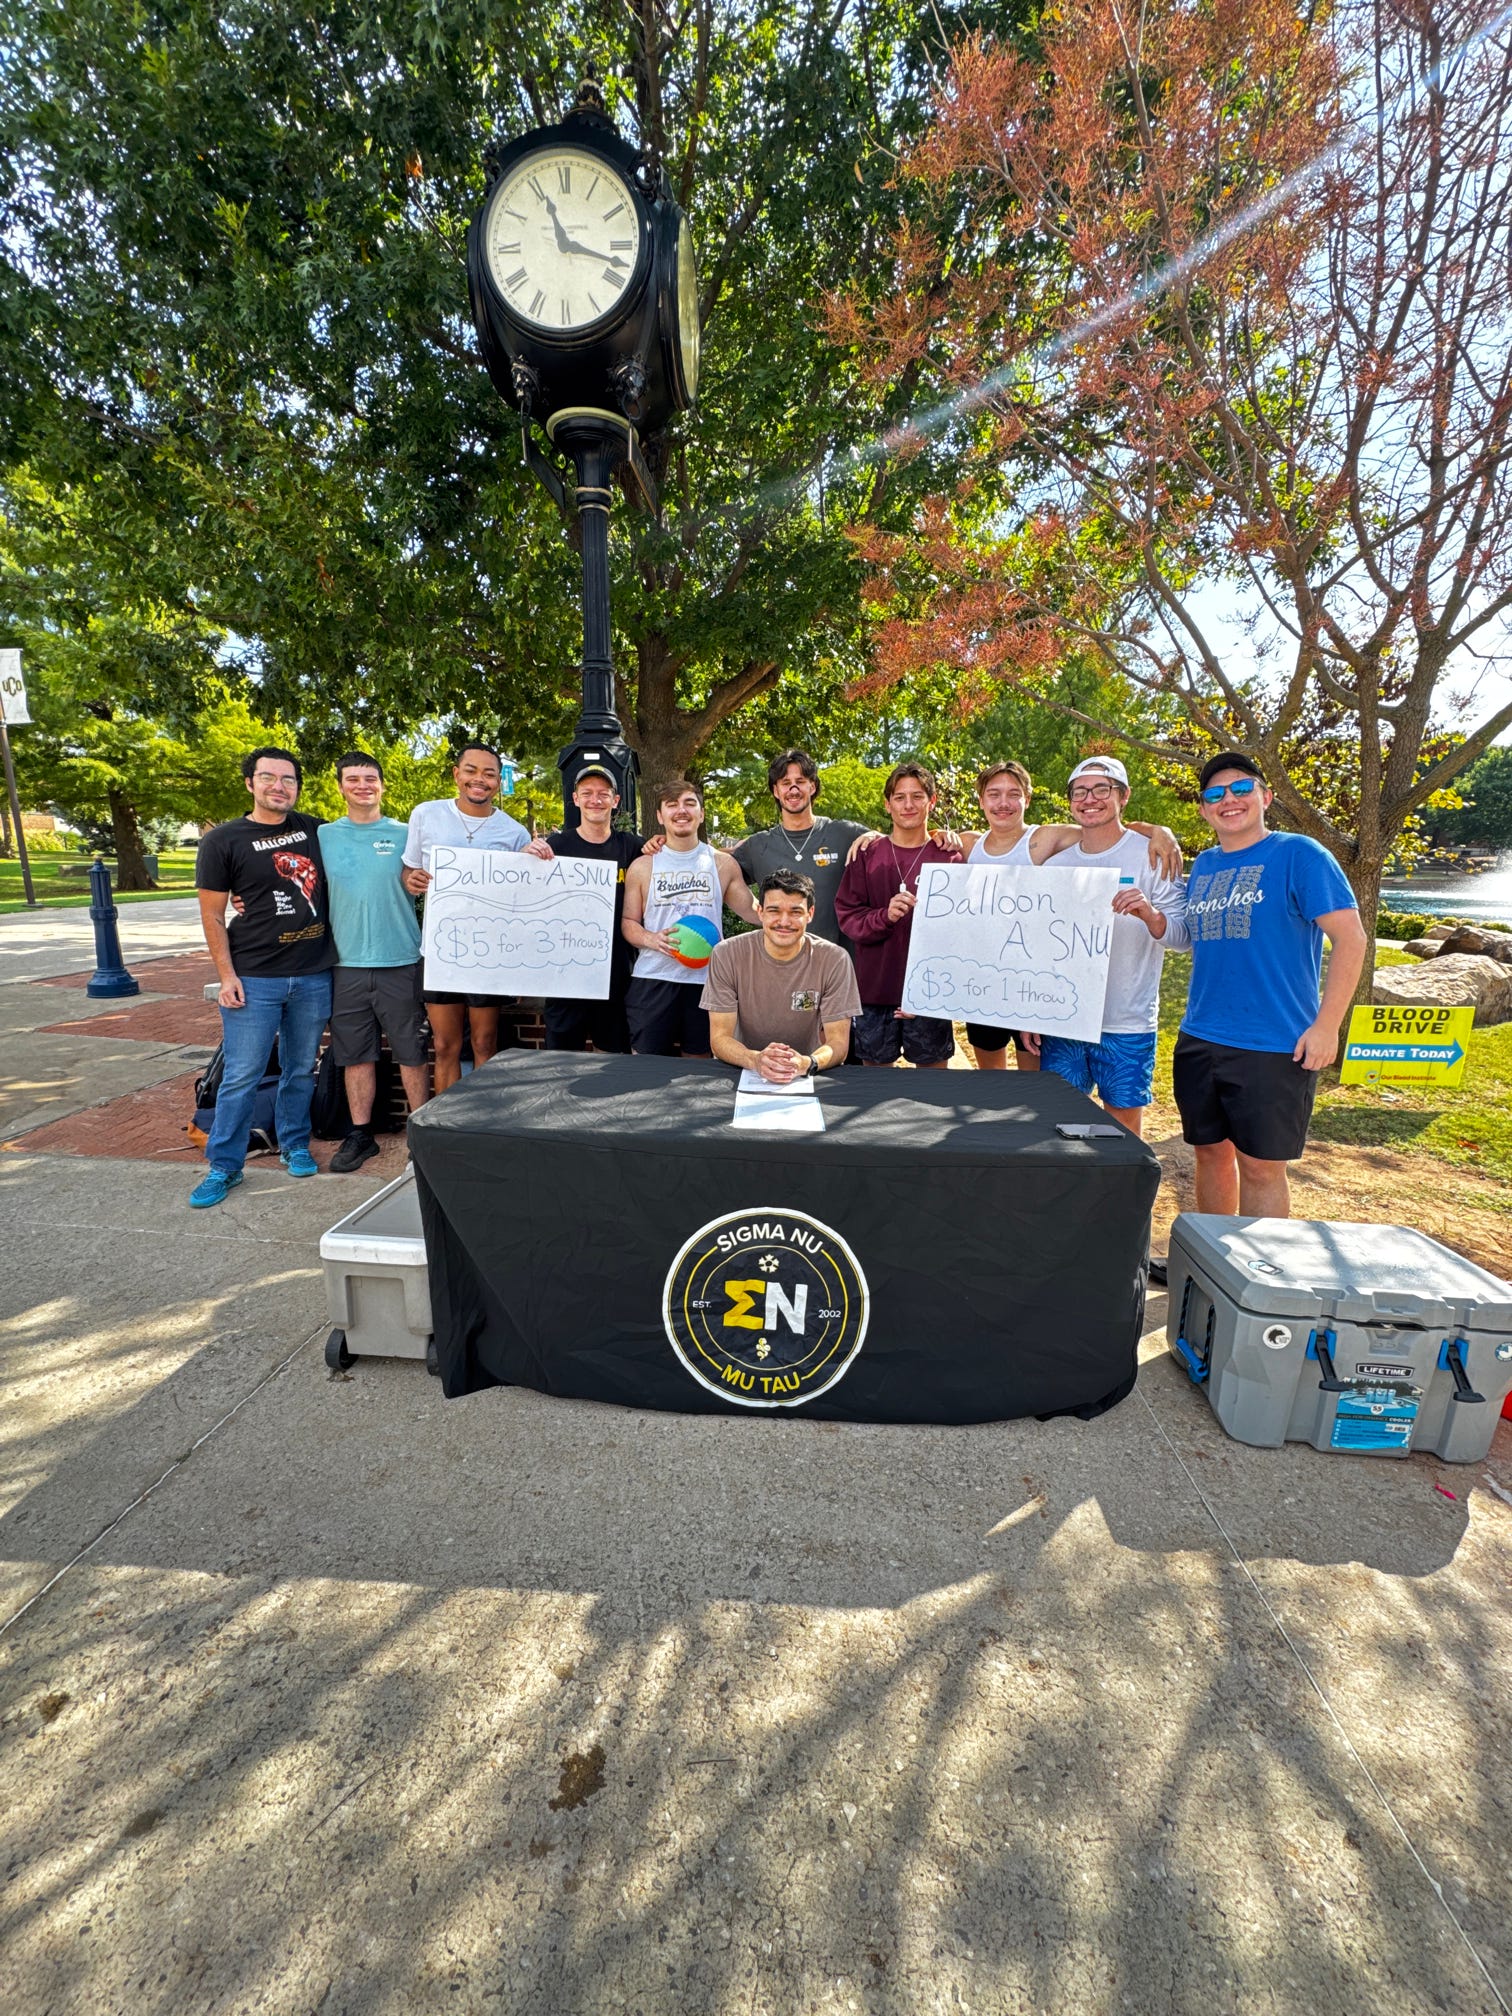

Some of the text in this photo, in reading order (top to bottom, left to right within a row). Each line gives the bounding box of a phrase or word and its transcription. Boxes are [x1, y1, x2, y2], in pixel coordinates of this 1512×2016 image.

[2, 677, 23, 696] UCO
[252, 831, 309, 852] HALLOWEEN
[657, 875, 707, 892] Bronchos
[925, 869, 1056, 918] Balloon
[448, 925, 604, 960] $5 for 3 throws
[999, 919, 1110, 961] A SNU
[921, 967, 1066, 1004] $3 for 1 throw
[1372, 1008, 1451, 1021] BLOOD
[1373, 1021, 1445, 1035] DRIVE
[716, 1223, 823, 1254] SIGMA NU
[692, 1300, 712, 1309] EST.
[818, 1309, 841, 1319] 2002
[721, 1364, 800, 1394] MU TAU
[1363, 1366, 1407, 1376] LIFETIME
